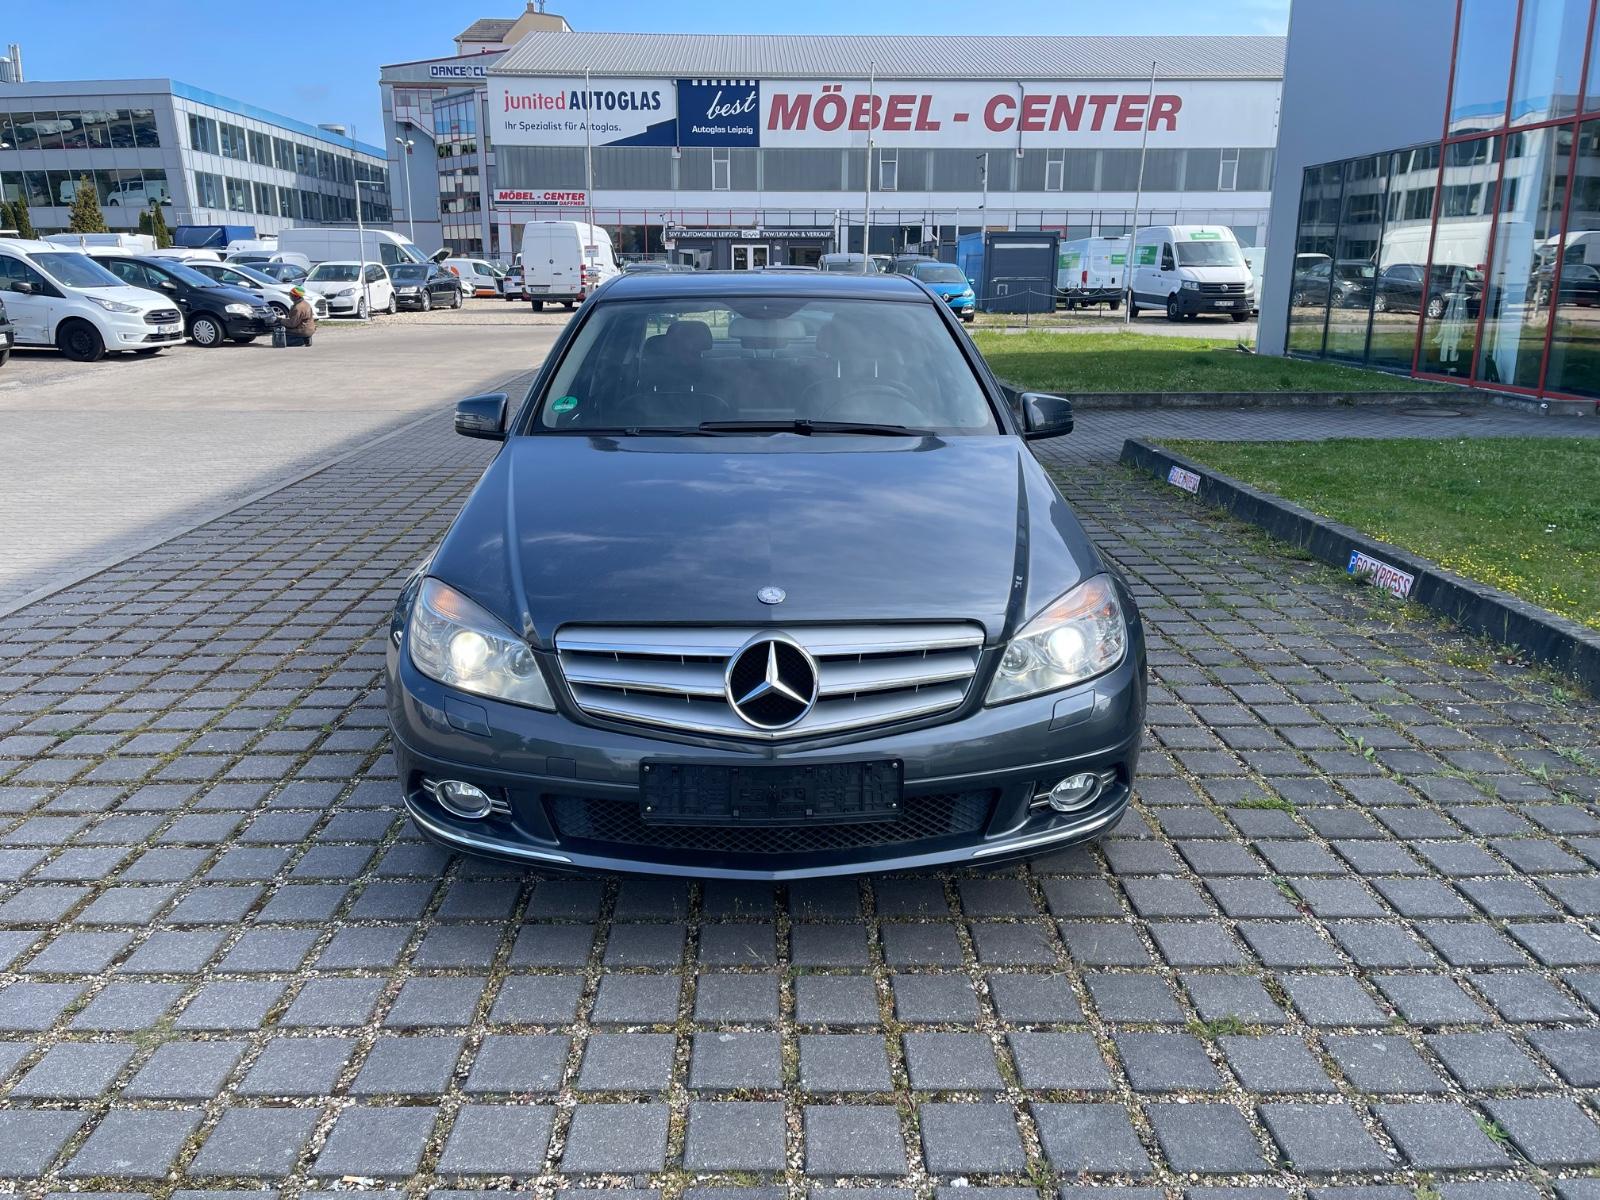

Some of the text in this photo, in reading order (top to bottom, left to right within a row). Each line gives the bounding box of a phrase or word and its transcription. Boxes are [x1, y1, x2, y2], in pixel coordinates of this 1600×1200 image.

[431, 66, 488, 76] DANCE CL
[504, 90, 661, 112] junited AUTOGLAS
[706, 90, 757, 120] best
[767, 84, 941, 132] MÖBEL
[983, 94, 1183, 132] CENTER
[504, 121, 516, 131] Ihr
[519, 121, 562, 132] Spezialist
[565, 121, 578, 131] für
[691, 125, 754, 135] Autoglas Leipzig
[499, 190, 535, 200] MÖBEL
[543, 191, 585, 201] CENTER
